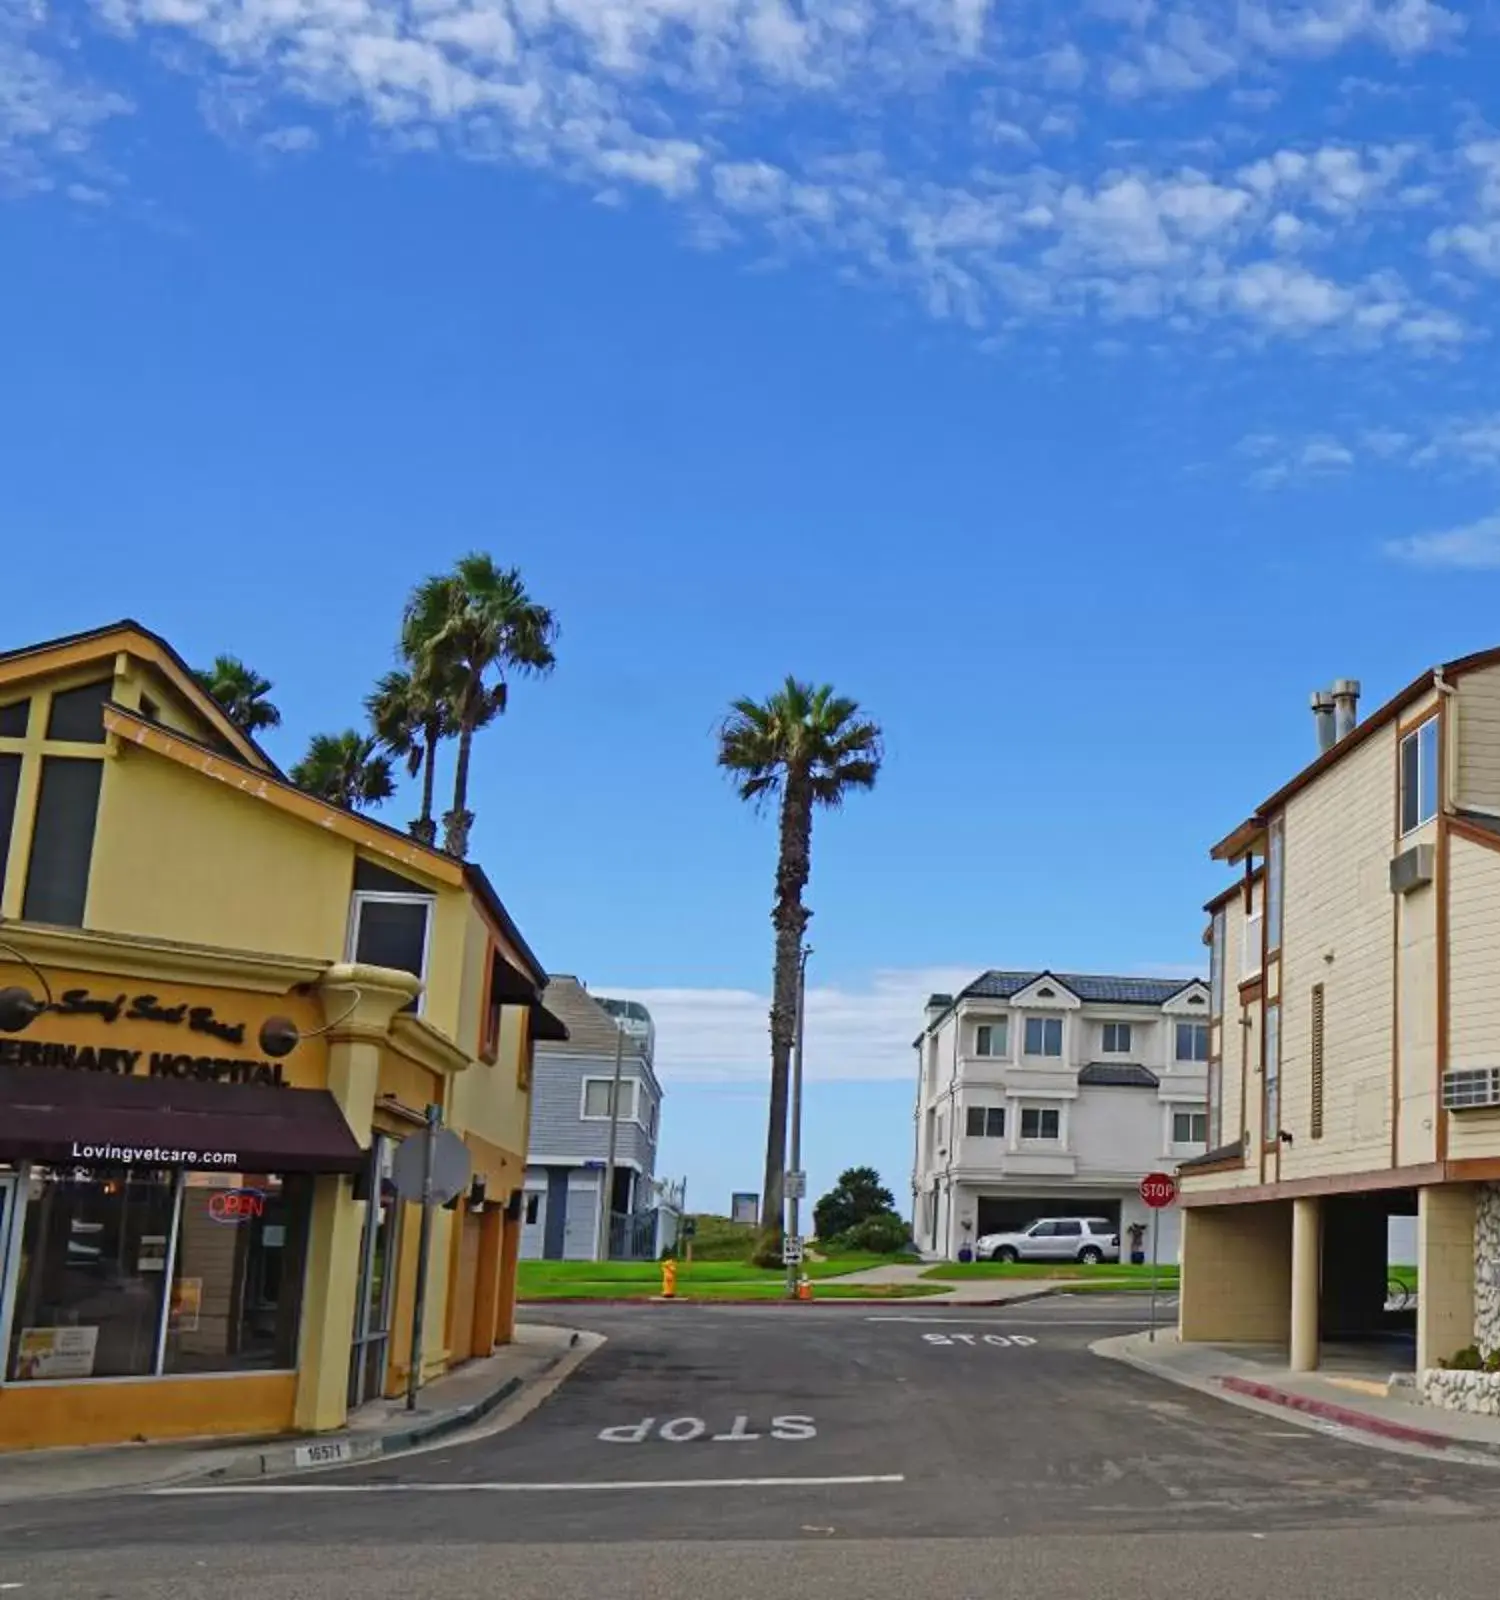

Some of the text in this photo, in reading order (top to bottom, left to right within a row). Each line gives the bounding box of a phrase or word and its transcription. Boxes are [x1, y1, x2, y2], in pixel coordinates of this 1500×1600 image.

[150, 1053, 290, 1087] HOSPITAL
[73, 1143, 238, 1163] Lovingvetcare.com
[1143, 1183, 1173, 1196] STOP
[209, 1194, 264, 1217] OPEN
[922, 1333, 1038, 1347] STOP
[597, 1415, 817, 1443] STOP
